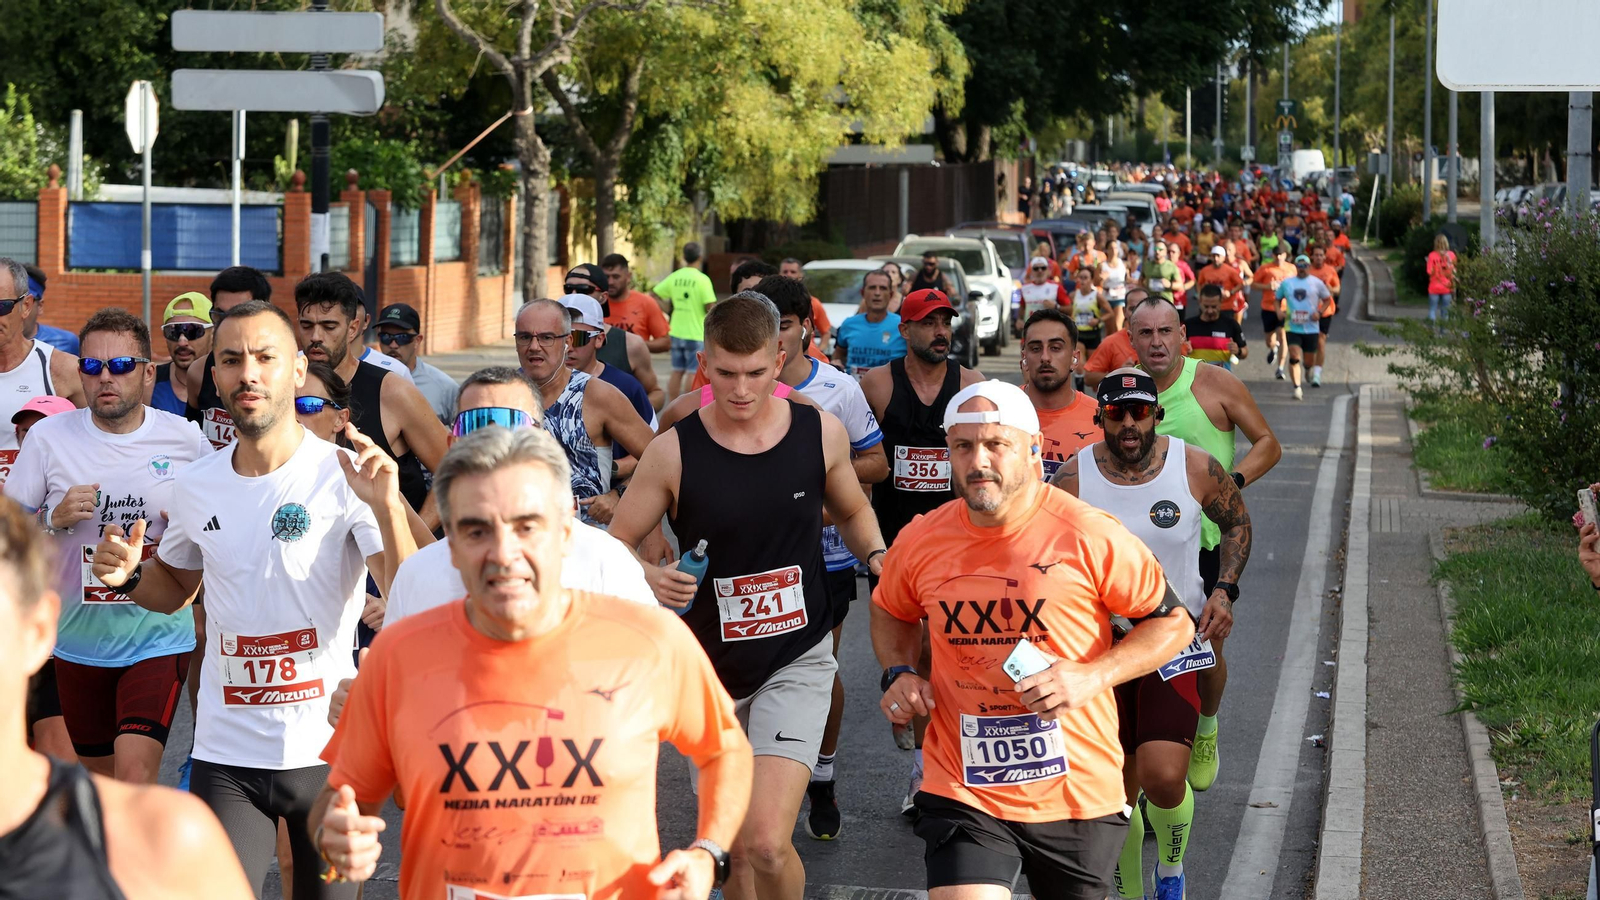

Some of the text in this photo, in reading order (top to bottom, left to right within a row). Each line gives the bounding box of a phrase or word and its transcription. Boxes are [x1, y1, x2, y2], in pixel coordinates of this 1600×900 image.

[908, 462, 938, 477] 356
[101, 494, 147, 514] Juntos
[101, 508, 148, 522] es más
[740, 591, 783, 618] 241
[938, 597, 1049, 634] XXIX
[948, 637, 978, 646] MEDIA
[1035, 634, 1049, 642] DE
[243, 657, 297, 683] 178
[977, 736, 1047, 763] 1050
[438, 737, 604, 793] XXIX
[444, 793, 598, 810] MEDIA MARATÓN DE
